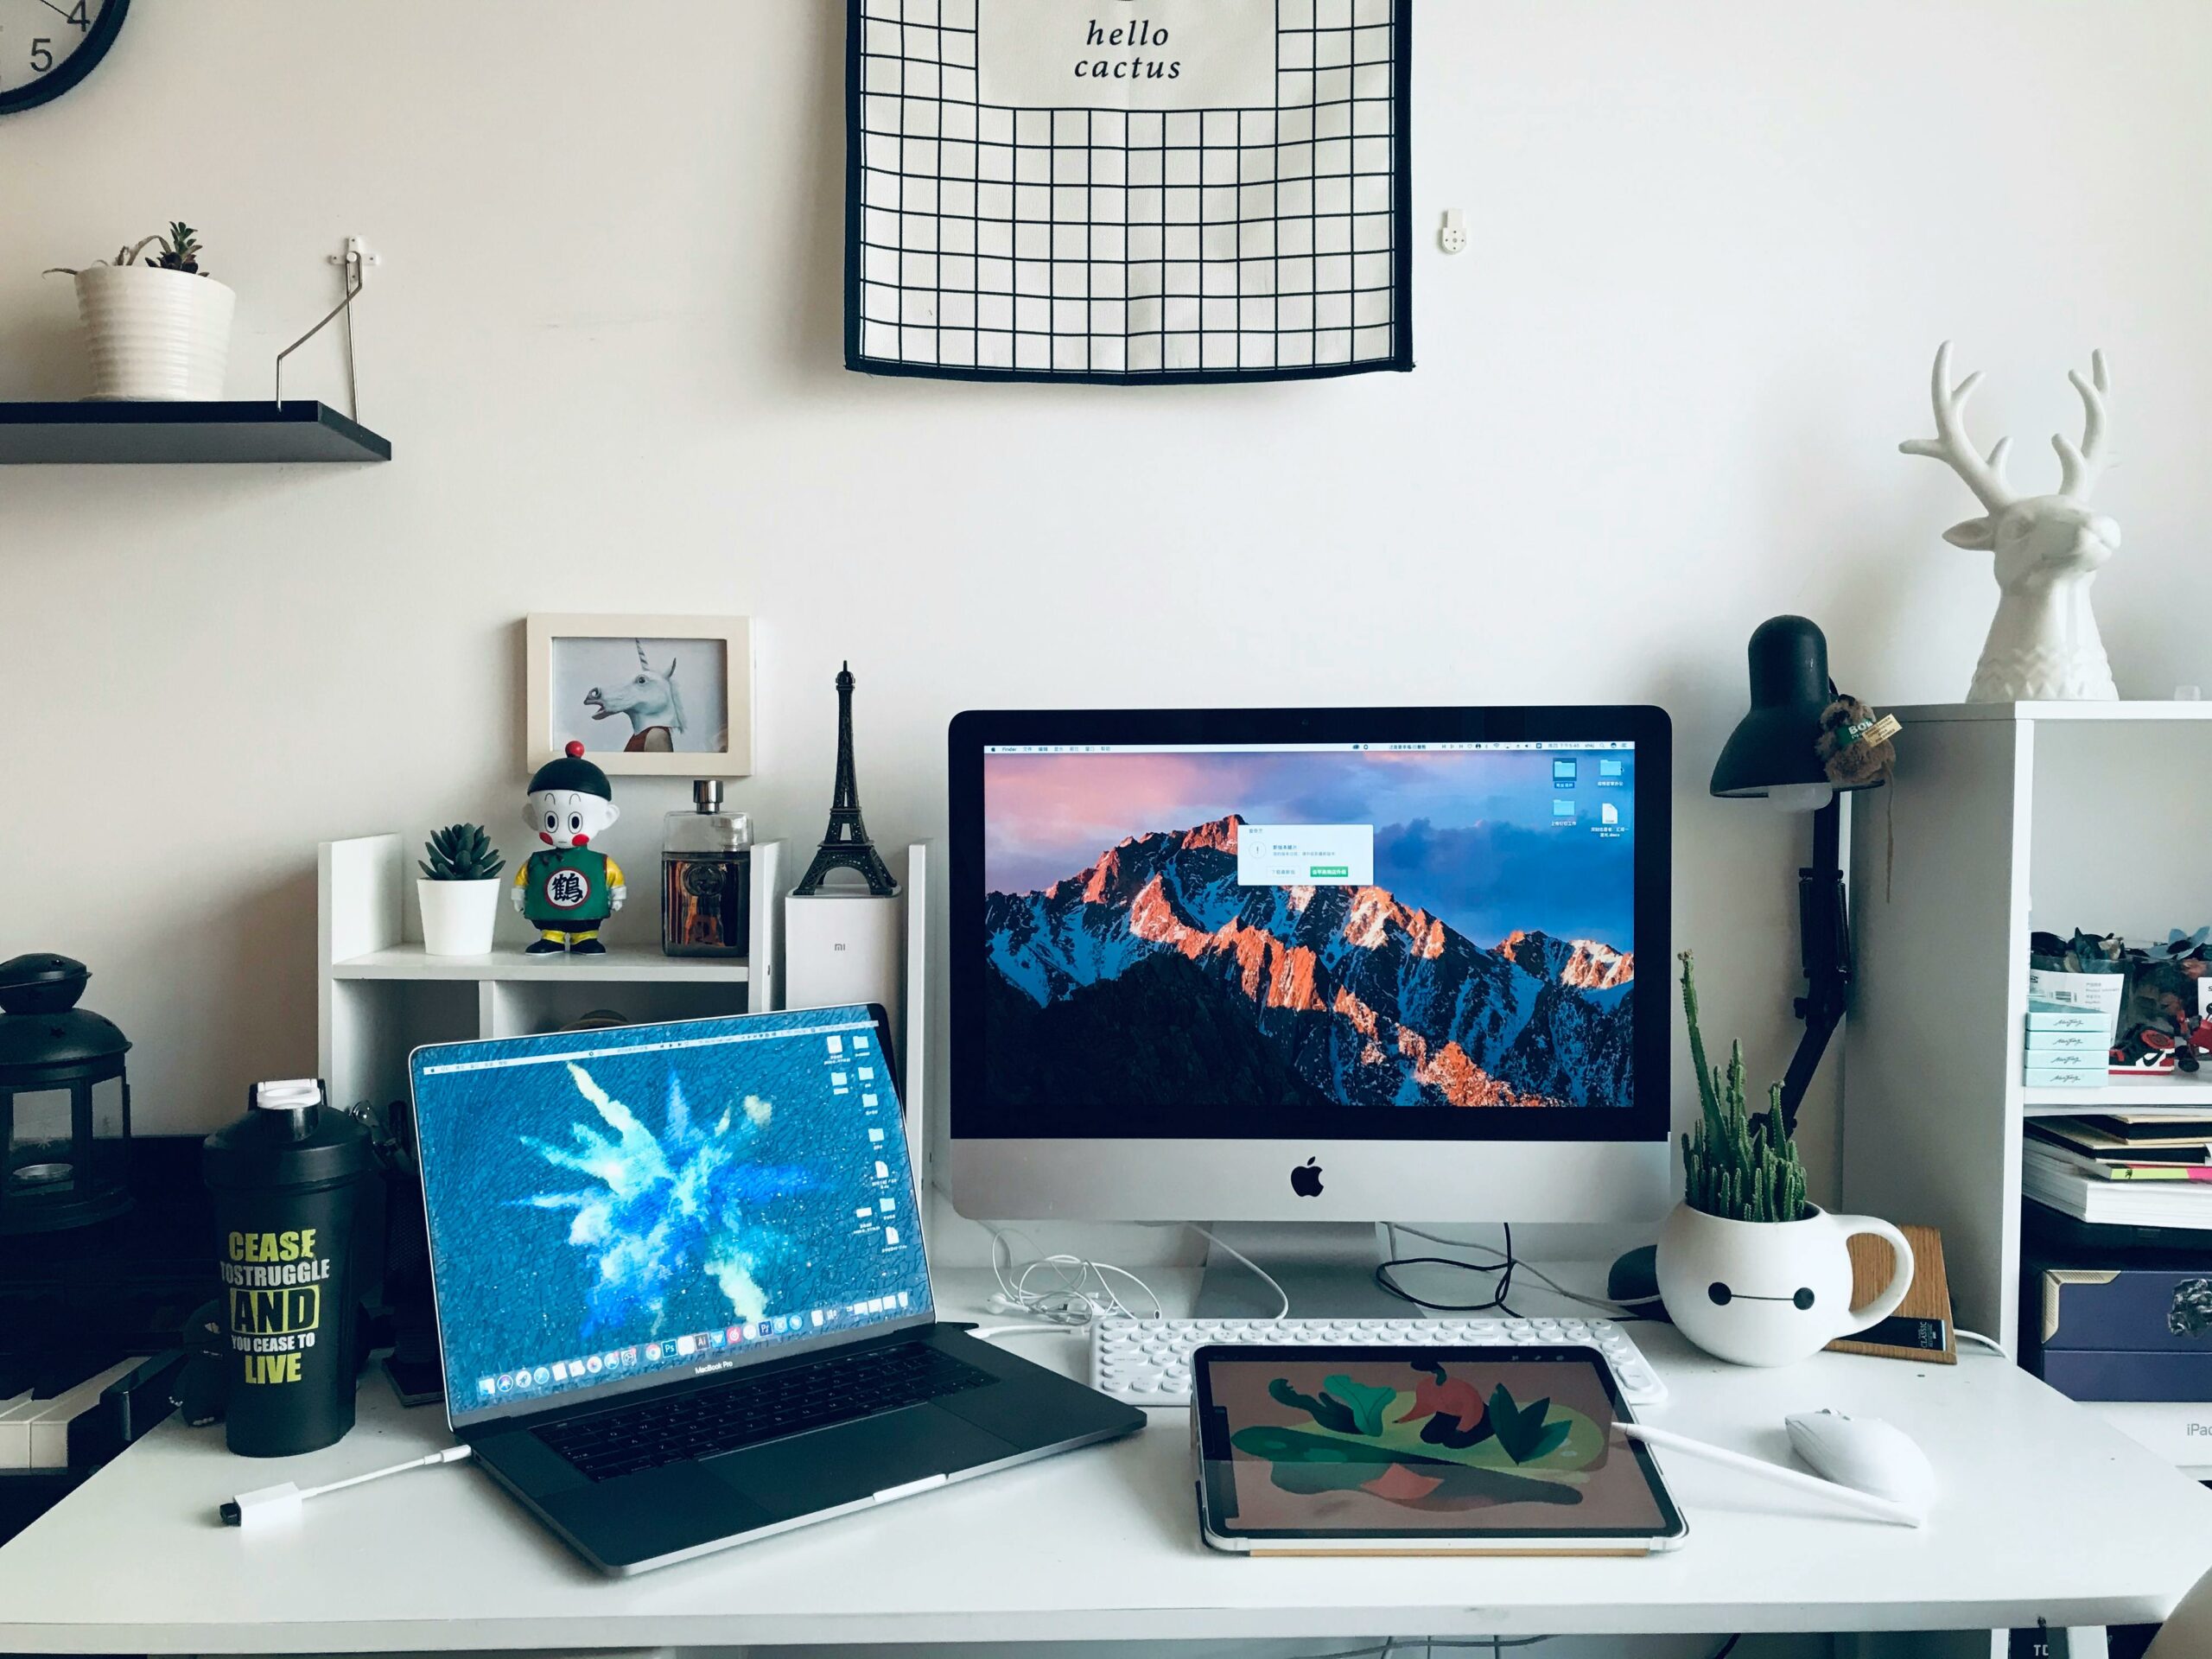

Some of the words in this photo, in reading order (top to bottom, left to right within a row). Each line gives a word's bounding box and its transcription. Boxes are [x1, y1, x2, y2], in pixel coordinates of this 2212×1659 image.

[1086, 19, 1169, 47] hello
[29, 38, 53, 72] 5
[1074, 57, 1181, 79] cactus
[228, 1229, 316, 1262] CEASE
[232, 1286, 319, 1334] AND
[232, 1335, 251, 1351] YOU
[253, 1335, 296, 1353] CEASE
[297, 1332, 315, 1348] TO
[1919, 1321, 1928, 1348] CLASSIC
[245, 1353, 302, 1384] LIVE
[695, 1363, 722, 1374] MacBook
[723, 1361, 734, 1370] Pro
